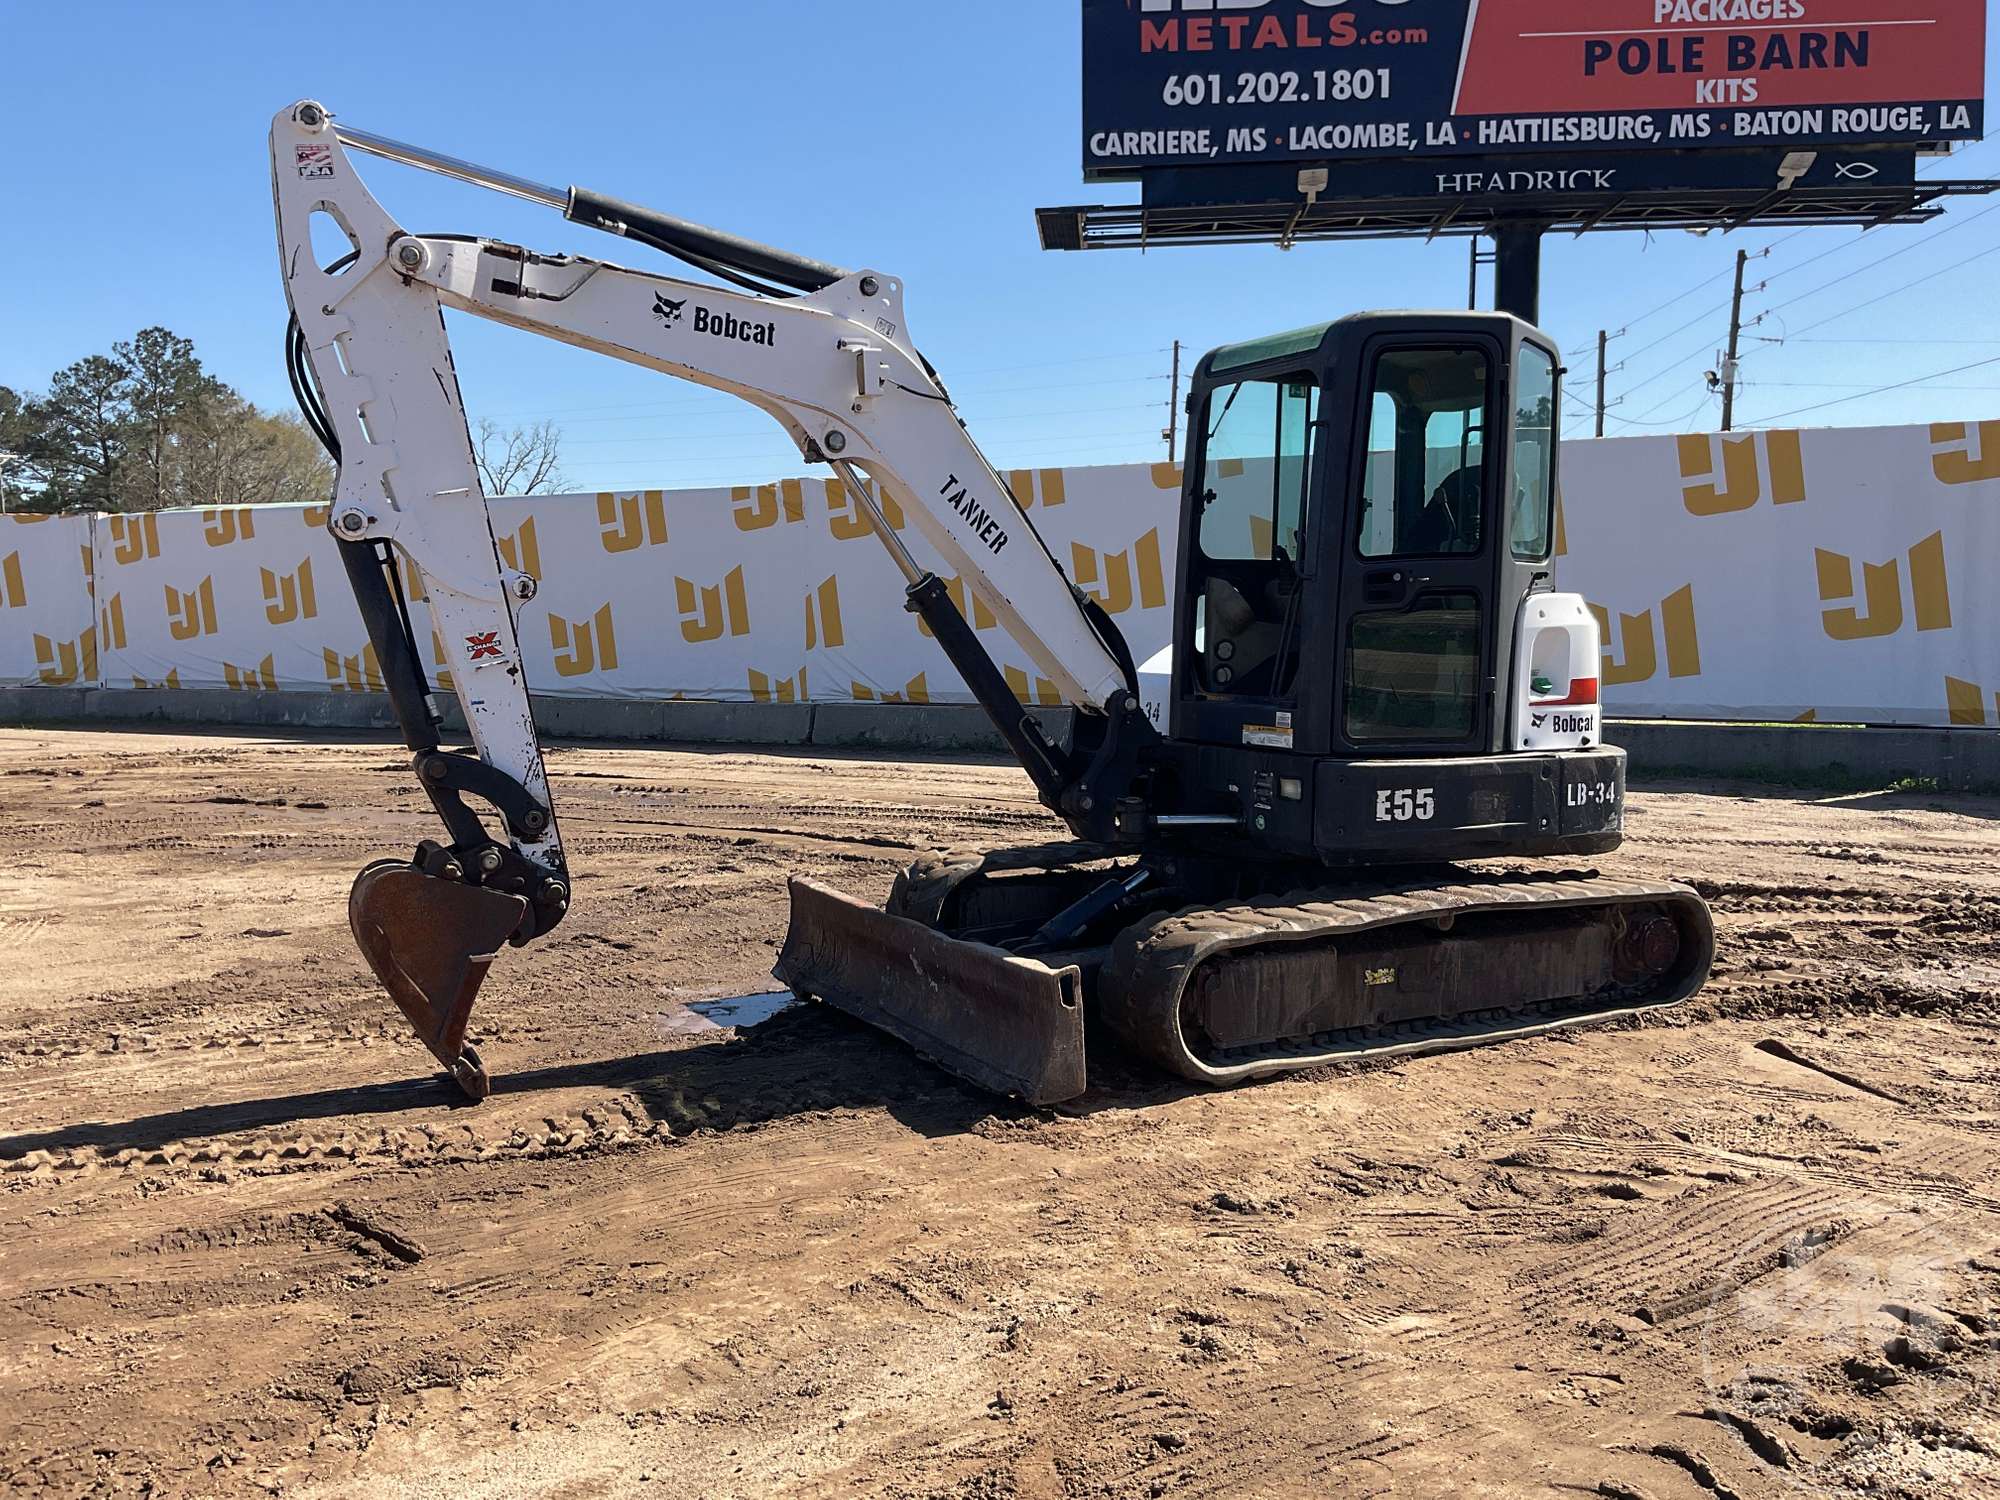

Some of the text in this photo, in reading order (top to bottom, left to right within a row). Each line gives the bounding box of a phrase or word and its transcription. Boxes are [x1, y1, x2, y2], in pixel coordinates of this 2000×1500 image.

[1654, 0, 1805, 23] PACKAGES
[1140, 12, 1428, 52] METALS.com
[1583, 30, 1869, 76] POLE BARN
[1162, 68, 1391, 106] 601.202.1801
[1695, 77, 1759, 104] KITS
[1090, 105, 1971, 157] CARRIERE, MS LACOMBE, LA HATTIESBURG, MS BATON ROUGE, LA
[1436, 169, 1617, 193] HEADRICK
[692, 305, 776, 348] Bobcat
[939, 473, 1009, 555] TANNER
[1552, 714, 1593, 733] Bobcat
[1375, 787, 1435, 822] E55
[1566, 781, 1616, 807] LB-34
